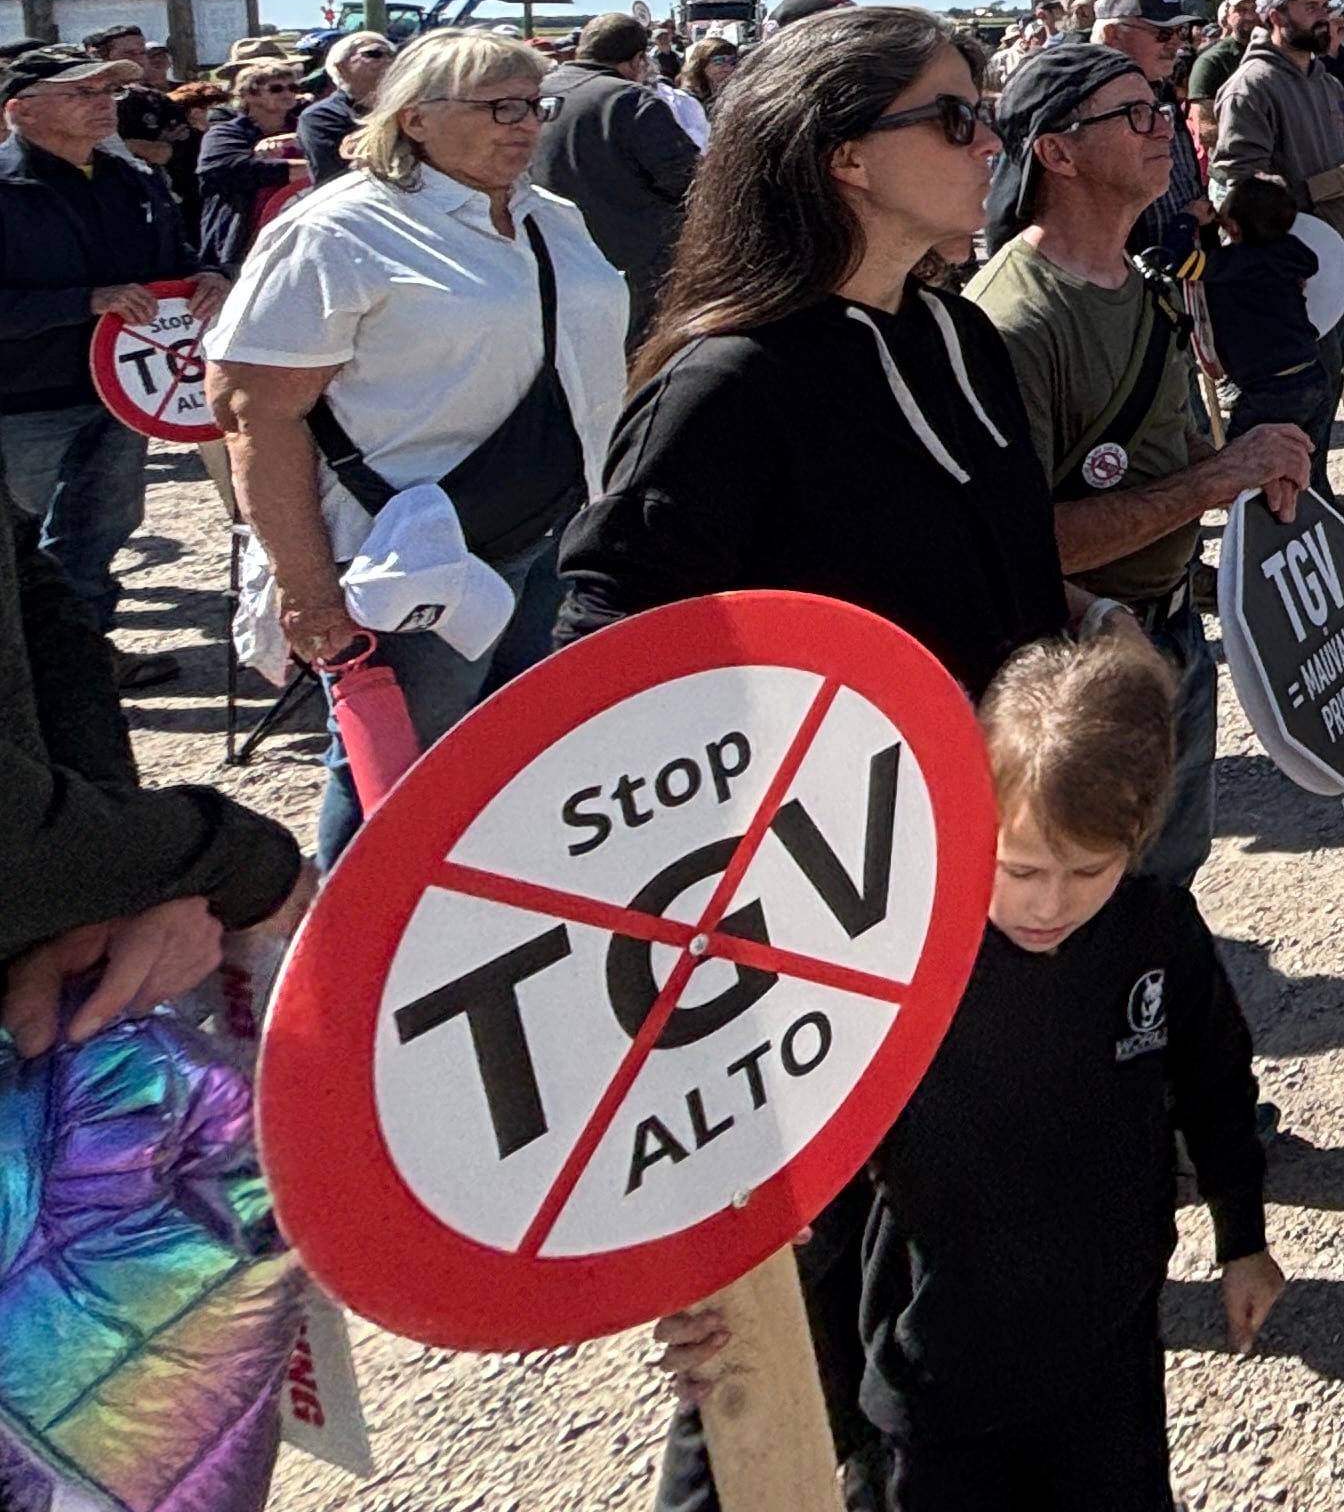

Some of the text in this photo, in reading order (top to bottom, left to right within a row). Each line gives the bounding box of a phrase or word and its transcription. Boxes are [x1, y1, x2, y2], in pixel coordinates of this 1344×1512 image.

[118, 338, 206, 396] TG
[150, 314, 194, 333] Stop
[1261, 520, 1344, 643] TGV
[561, 730, 752, 857] Stop
[392, 741, 902, 1161] TGV
[624, 1010, 833, 1197] ALTO
